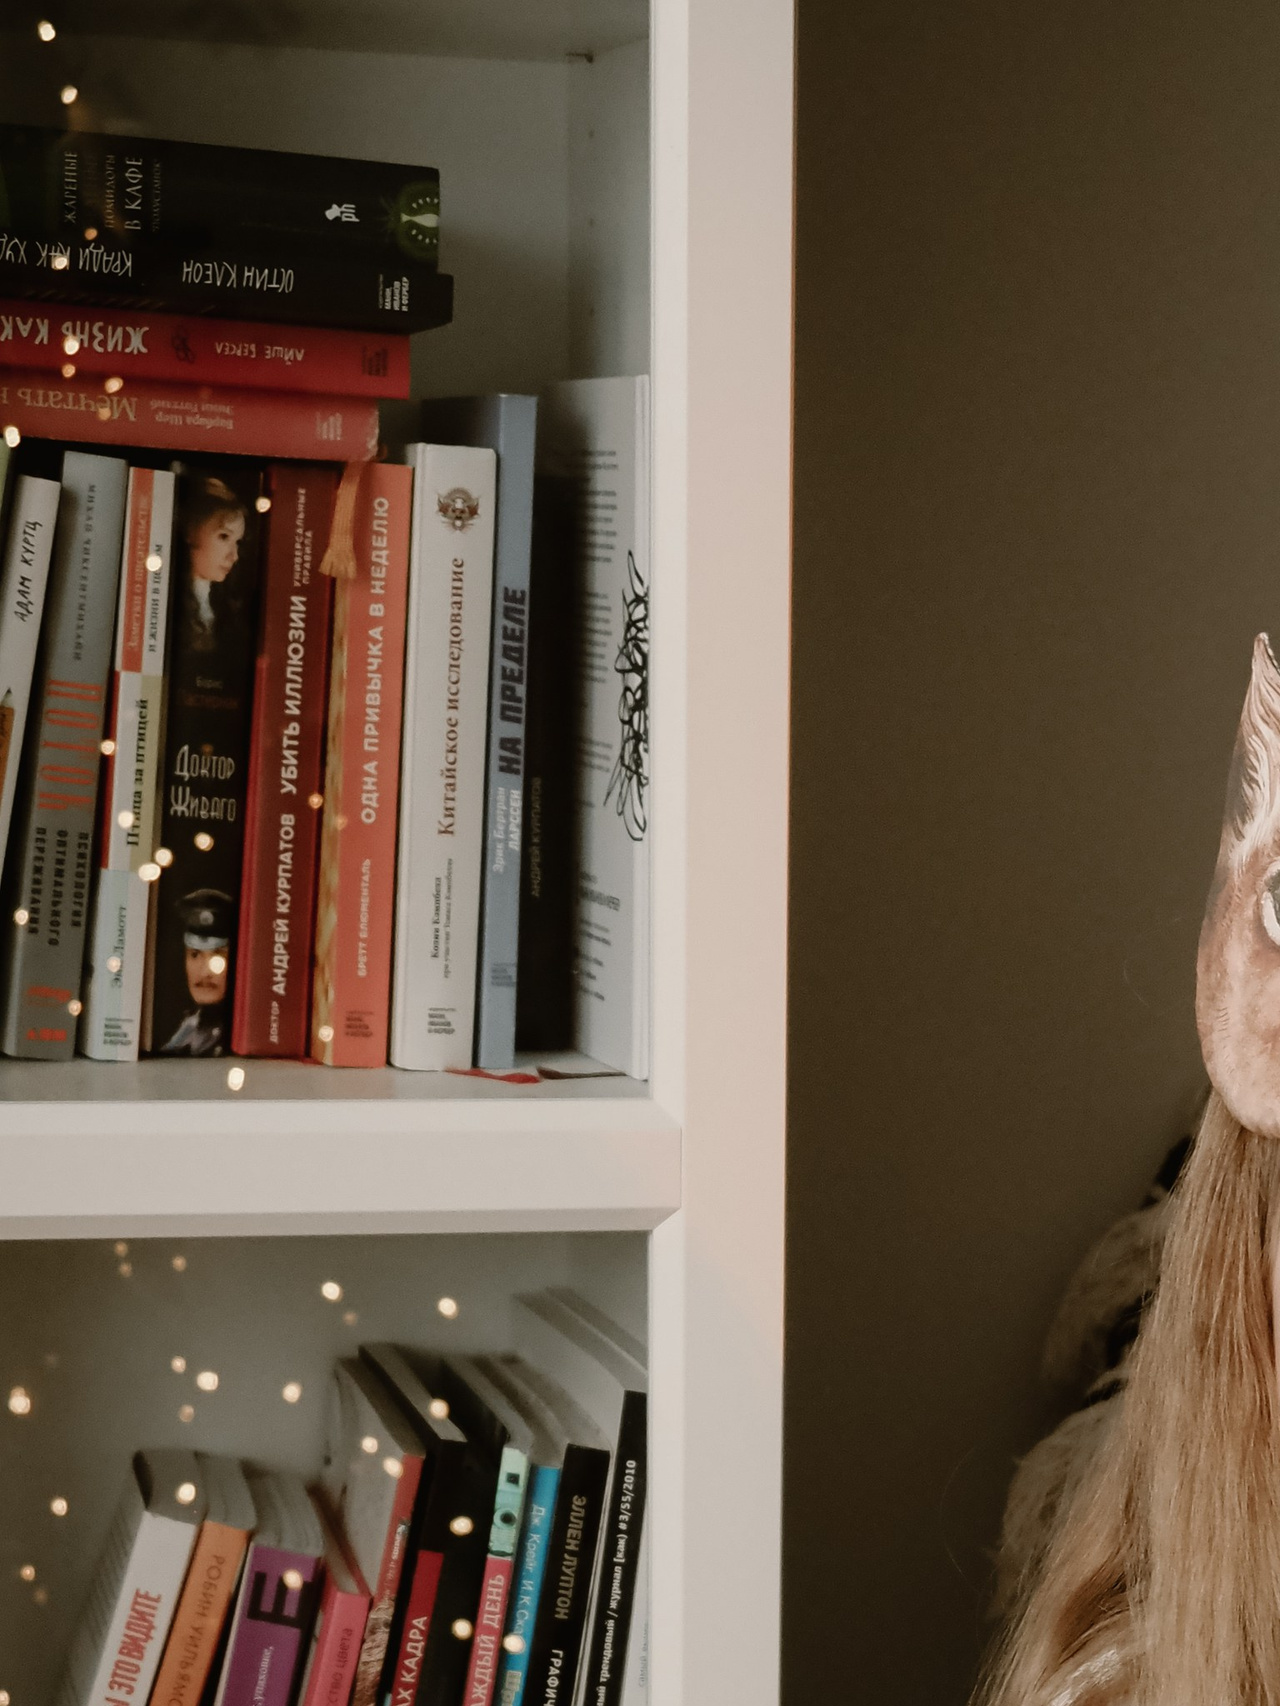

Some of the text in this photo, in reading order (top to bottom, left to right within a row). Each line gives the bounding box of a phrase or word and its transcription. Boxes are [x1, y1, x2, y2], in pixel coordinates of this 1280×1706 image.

[63, 150, 77, 223] ЖАРЕНЫЕ
[123, 157, 144, 229] В КАФЕ
[79, 243, 132, 277] КРАДИ
[182, 259, 294, 293] ОСТИН КЛЕОН
[0, 315, 149, 354] ЖИЗНЬ КАК
[215, 342, 304, 366] АЙШЕ БЕРСЕЛ
[17, 386, 137, 422] Мечтать
[14, 521, 42, 622] АДАМ КУРТЦ
[293, 488, 306, 586] УНИВЕРСАЛЬНЫЕ
[302, 530, 312, 584] ПРАВИЛА
[280, 595, 307, 794] УБИТЬ ИЛЛЮЗИИ
[360, 497, 391, 824] ОДНА ПРИВЫЧКА В НЕДЕЛЮ
[437, 558, 465, 835] Китайское исследование
[498, 586, 529, 775] НА ПРЕДЕЛЕ
[133, 698, 150, 763] птицей
[134, 768, 144, 782] за
[492, 786, 508, 872] Эрик Бертран
[508, 789, 522, 850] ЛАРССЕН
[27, 827, 46, 934] ПЕРЕЖИВАНИЯ
[47, 829, 68, 946] ОПТИМАЛЬНОГО
[71, 832, 89, 927] ПСИХОЛОГИЯ
[269, 813, 295, 1043] ДОКТОР АНДРЕЙ КУРПАТОВ
[357, 858, 371, 976] БРЕТТ БЛЮМЕНТАЛЬ
[196, 1554, 226, 1618] РОБИН
[554, 1494, 587, 1619] ЭЛЛЕН ЛУПТОН
[599, 1619, 615, 1682] трендовый
[609, 1565, 622, 1609] журнал
[618, 1459, 637, 1530] #3/55/2010
[117, 1588, 162, 1662] ВИДИТЕ
[482, 1574, 505, 1628] ДЕНЬ
[108, 1659, 141, 1696] ЭТО
[336, 1627, 353, 1669] цвета
[400, 1616, 428, 1683] КАДРА
